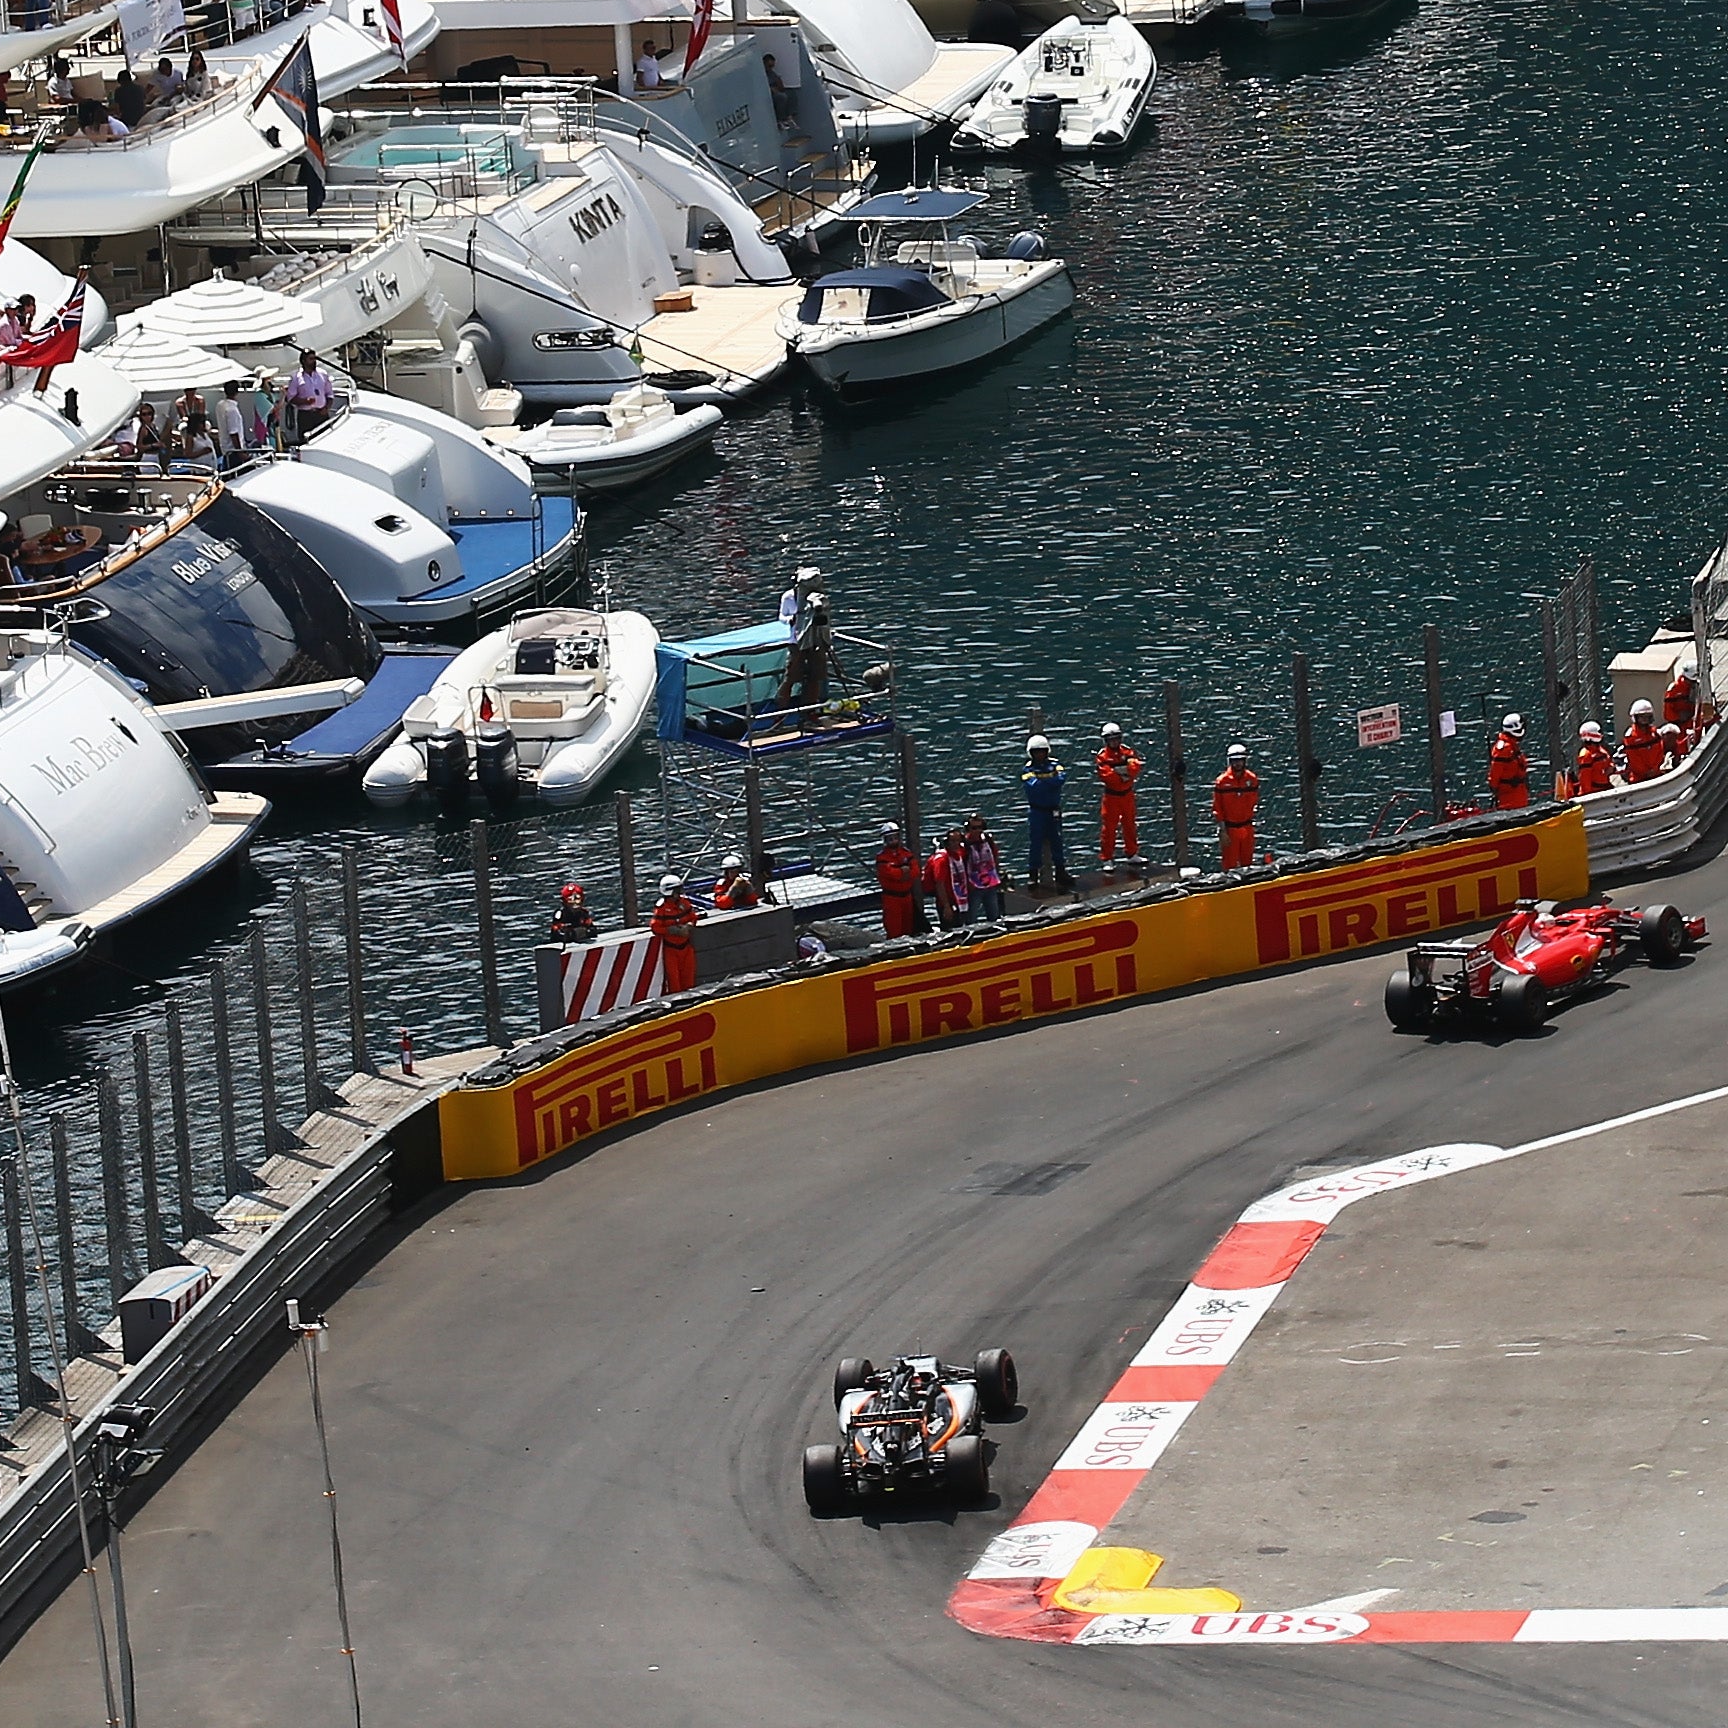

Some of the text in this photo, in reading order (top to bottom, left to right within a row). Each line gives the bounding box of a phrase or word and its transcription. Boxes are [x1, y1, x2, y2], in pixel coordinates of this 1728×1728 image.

[171, 556, 213, 585] Blue
[31, 735, 129, 796] Mac Brew
[1254, 833, 1540, 965] PIRELLI
[842, 919, 1139, 1054] PIRELLI
[513, 1012, 717, 1167] PIRELLI
[1165, 1317, 1234, 1356] UBS
[1084, 1424, 1157, 1467] UBS
[1189, 1613, 1342, 1637] UBS
